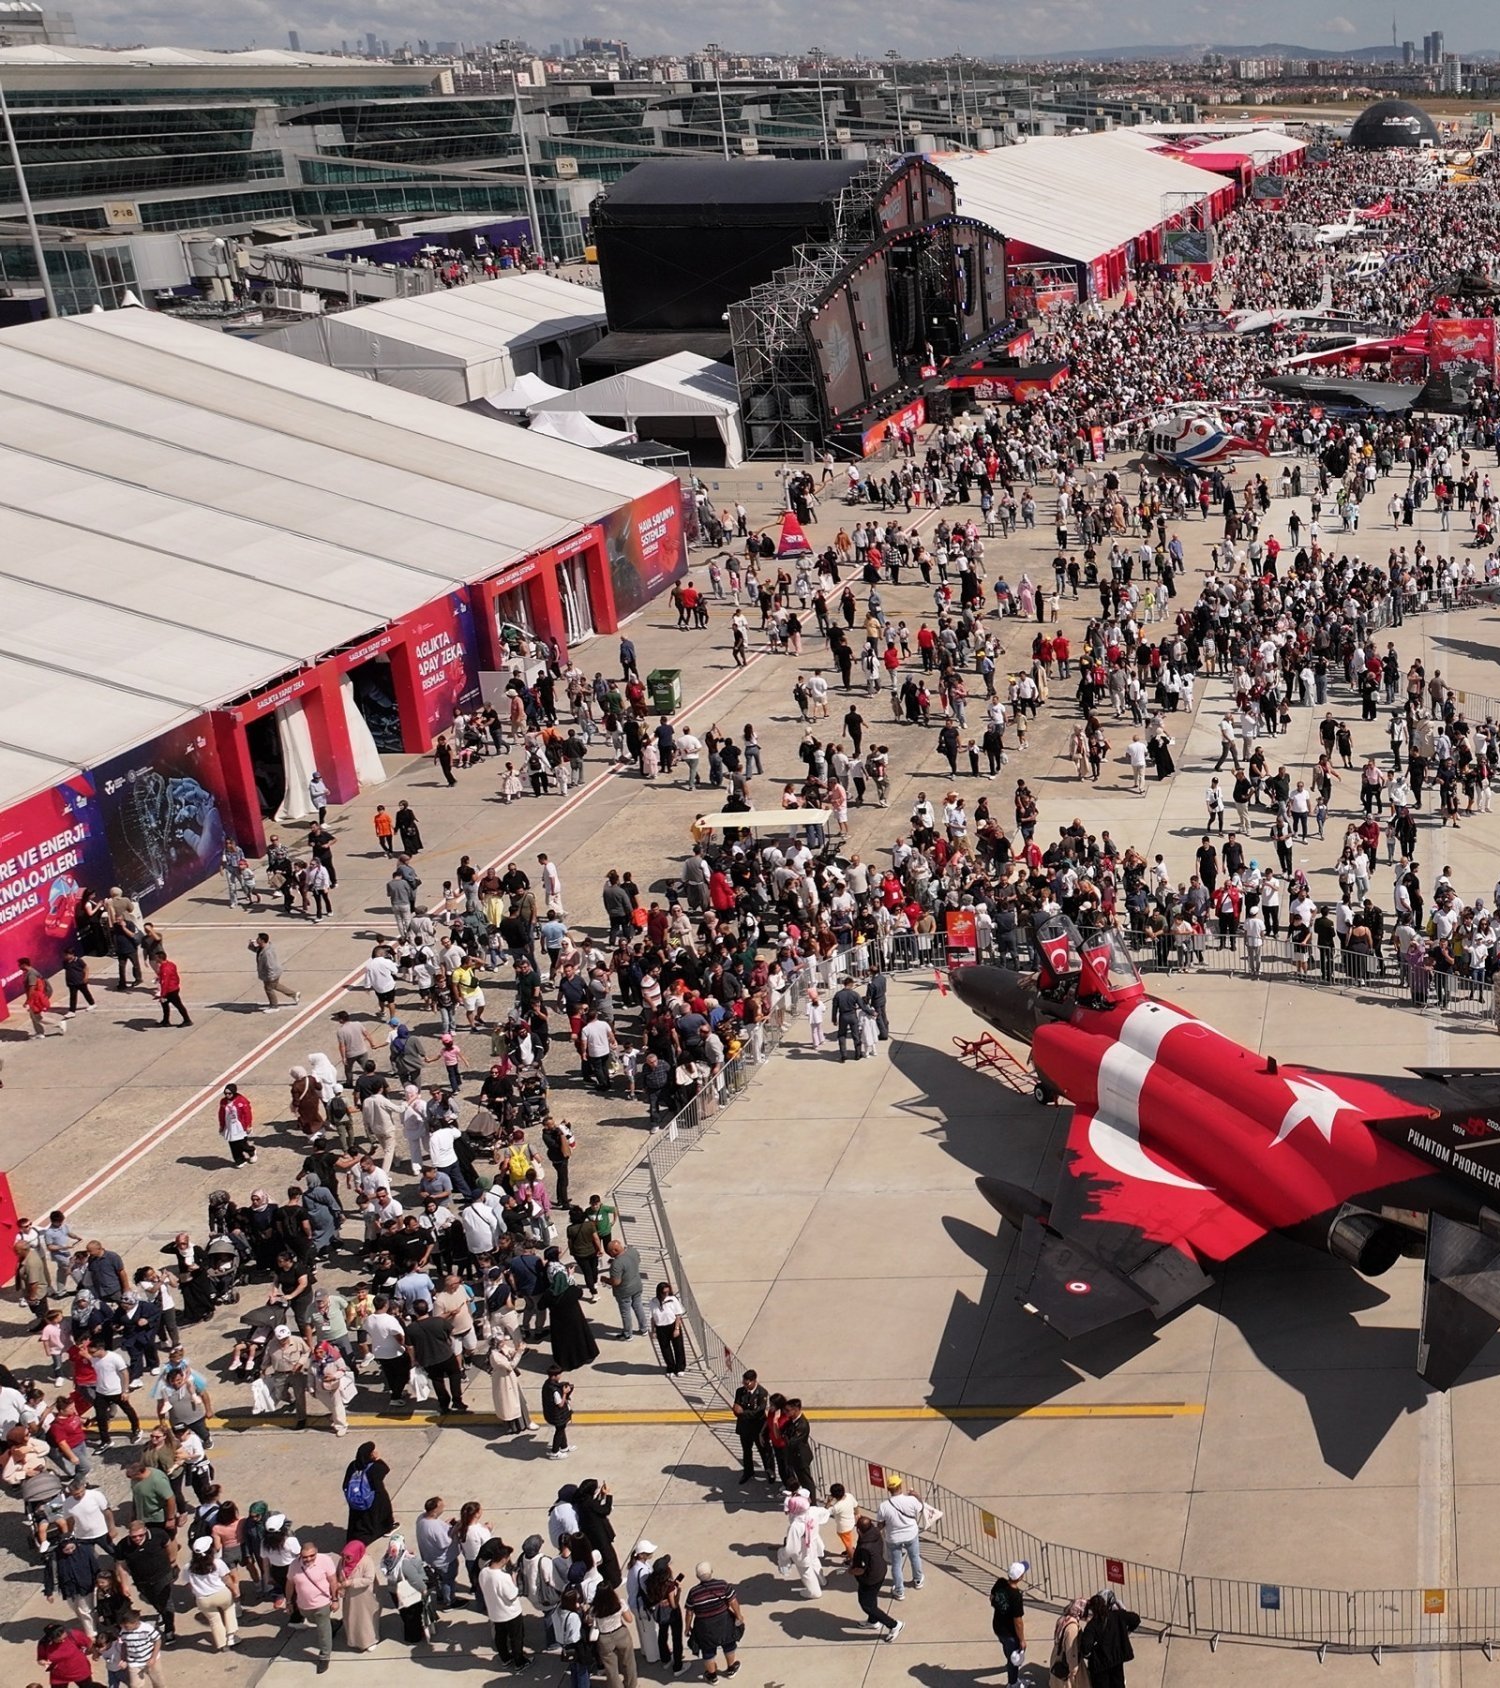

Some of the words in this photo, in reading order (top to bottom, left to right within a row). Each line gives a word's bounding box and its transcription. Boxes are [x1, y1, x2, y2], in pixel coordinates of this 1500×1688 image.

[418, 654, 440, 677] APAY
[442, 642, 464, 666] ZEKA
[18, 850, 39, 871] VE
[1452, 1123, 1466, 1137] 1974
[1407, 1128, 1451, 1163] PHANTOM
